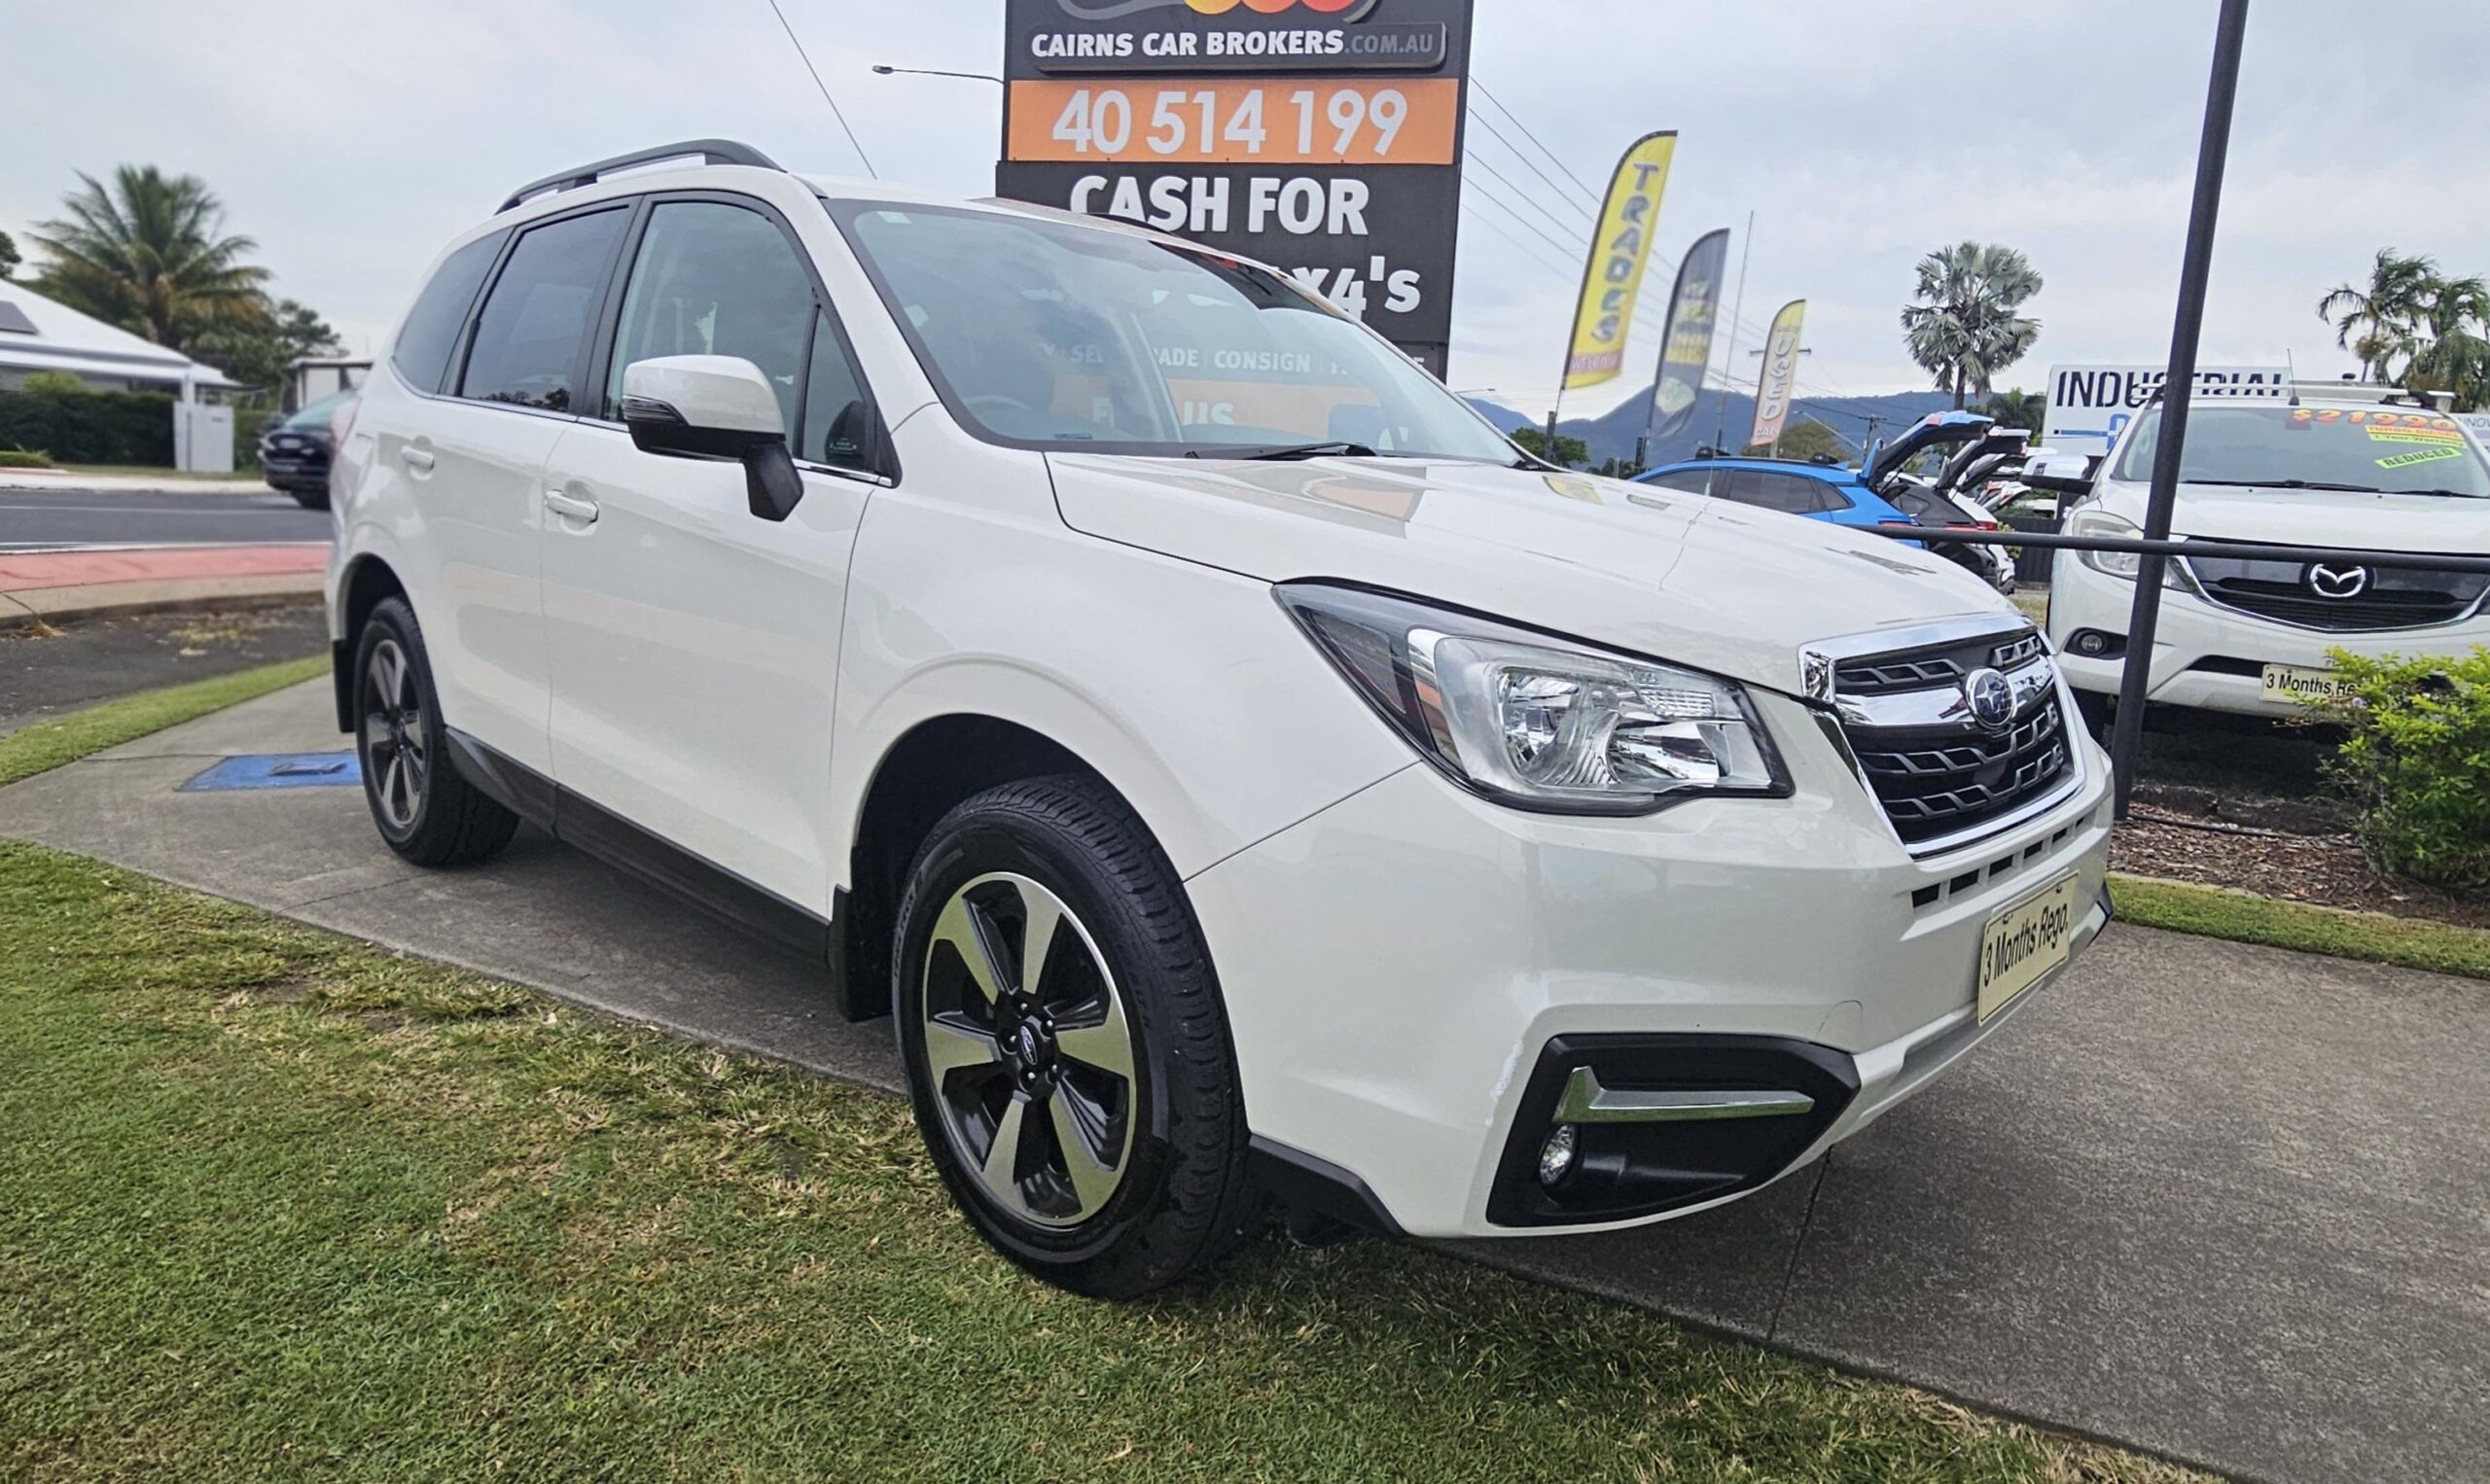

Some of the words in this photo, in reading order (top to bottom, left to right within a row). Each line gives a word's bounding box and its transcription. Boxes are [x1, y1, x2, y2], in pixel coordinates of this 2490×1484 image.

[1031, 33, 1133, 58] CAIRNS
[1142, 32, 1197, 57] CAR
[1206, 30, 1434, 55] BROKERS.COM.AU
[1051, 88, 1132, 154] 40
[1146, 89, 1266, 156] 514
[1290, 88, 1408, 157] 199
[1070, 175, 1230, 233] CASH
[1248, 177, 1370, 235] FOR
[1589, 161, 1660, 343] TRADES
[1155, 347, 1199, 368] ADE
[1213, 350, 1311, 373] CONSIGN
[1762, 336, 1796, 421] USED
[2292, 407, 2457, 432] $21990
[2383, 447, 2454, 467] REDUCED
[2266, 673, 2275, 689] 3
[2279, 674, 2331, 694] Months
[1984, 943, 1992, 987] 3
[1994, 918, 2038, 980] Months
